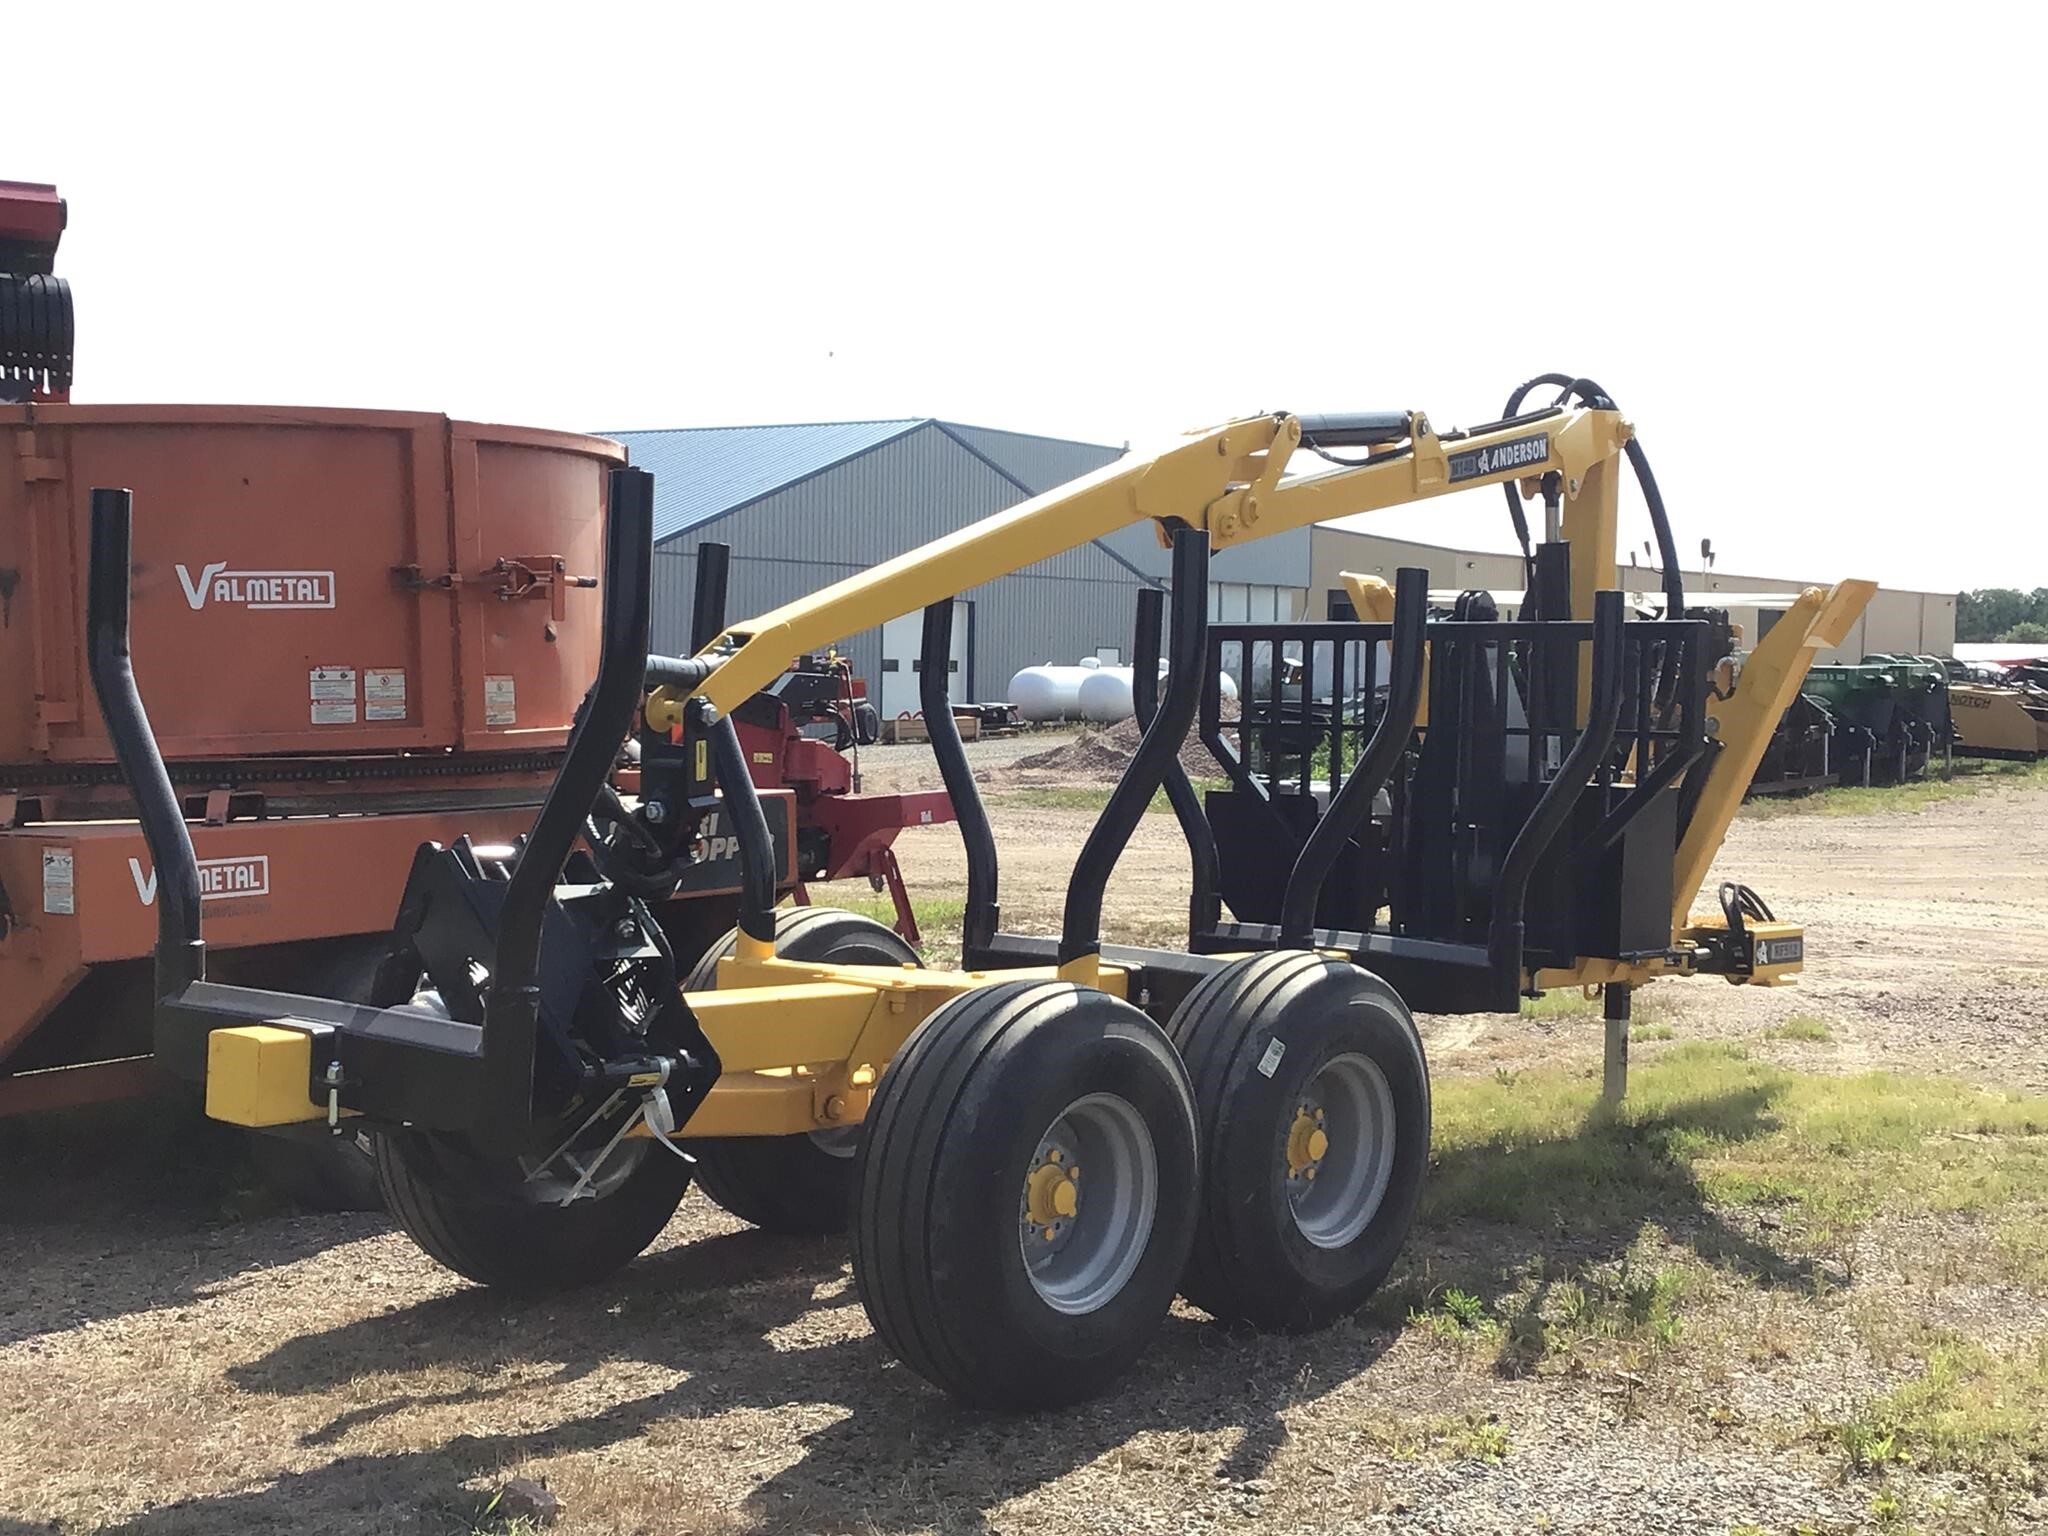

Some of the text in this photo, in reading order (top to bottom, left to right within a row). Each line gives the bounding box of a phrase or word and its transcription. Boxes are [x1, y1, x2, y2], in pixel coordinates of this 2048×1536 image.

[1490, 438, 1547, 470] ANDERSON
[175, 561, 326, 610] VALMETAL
[128, 857, 261, 906] VMETAL
